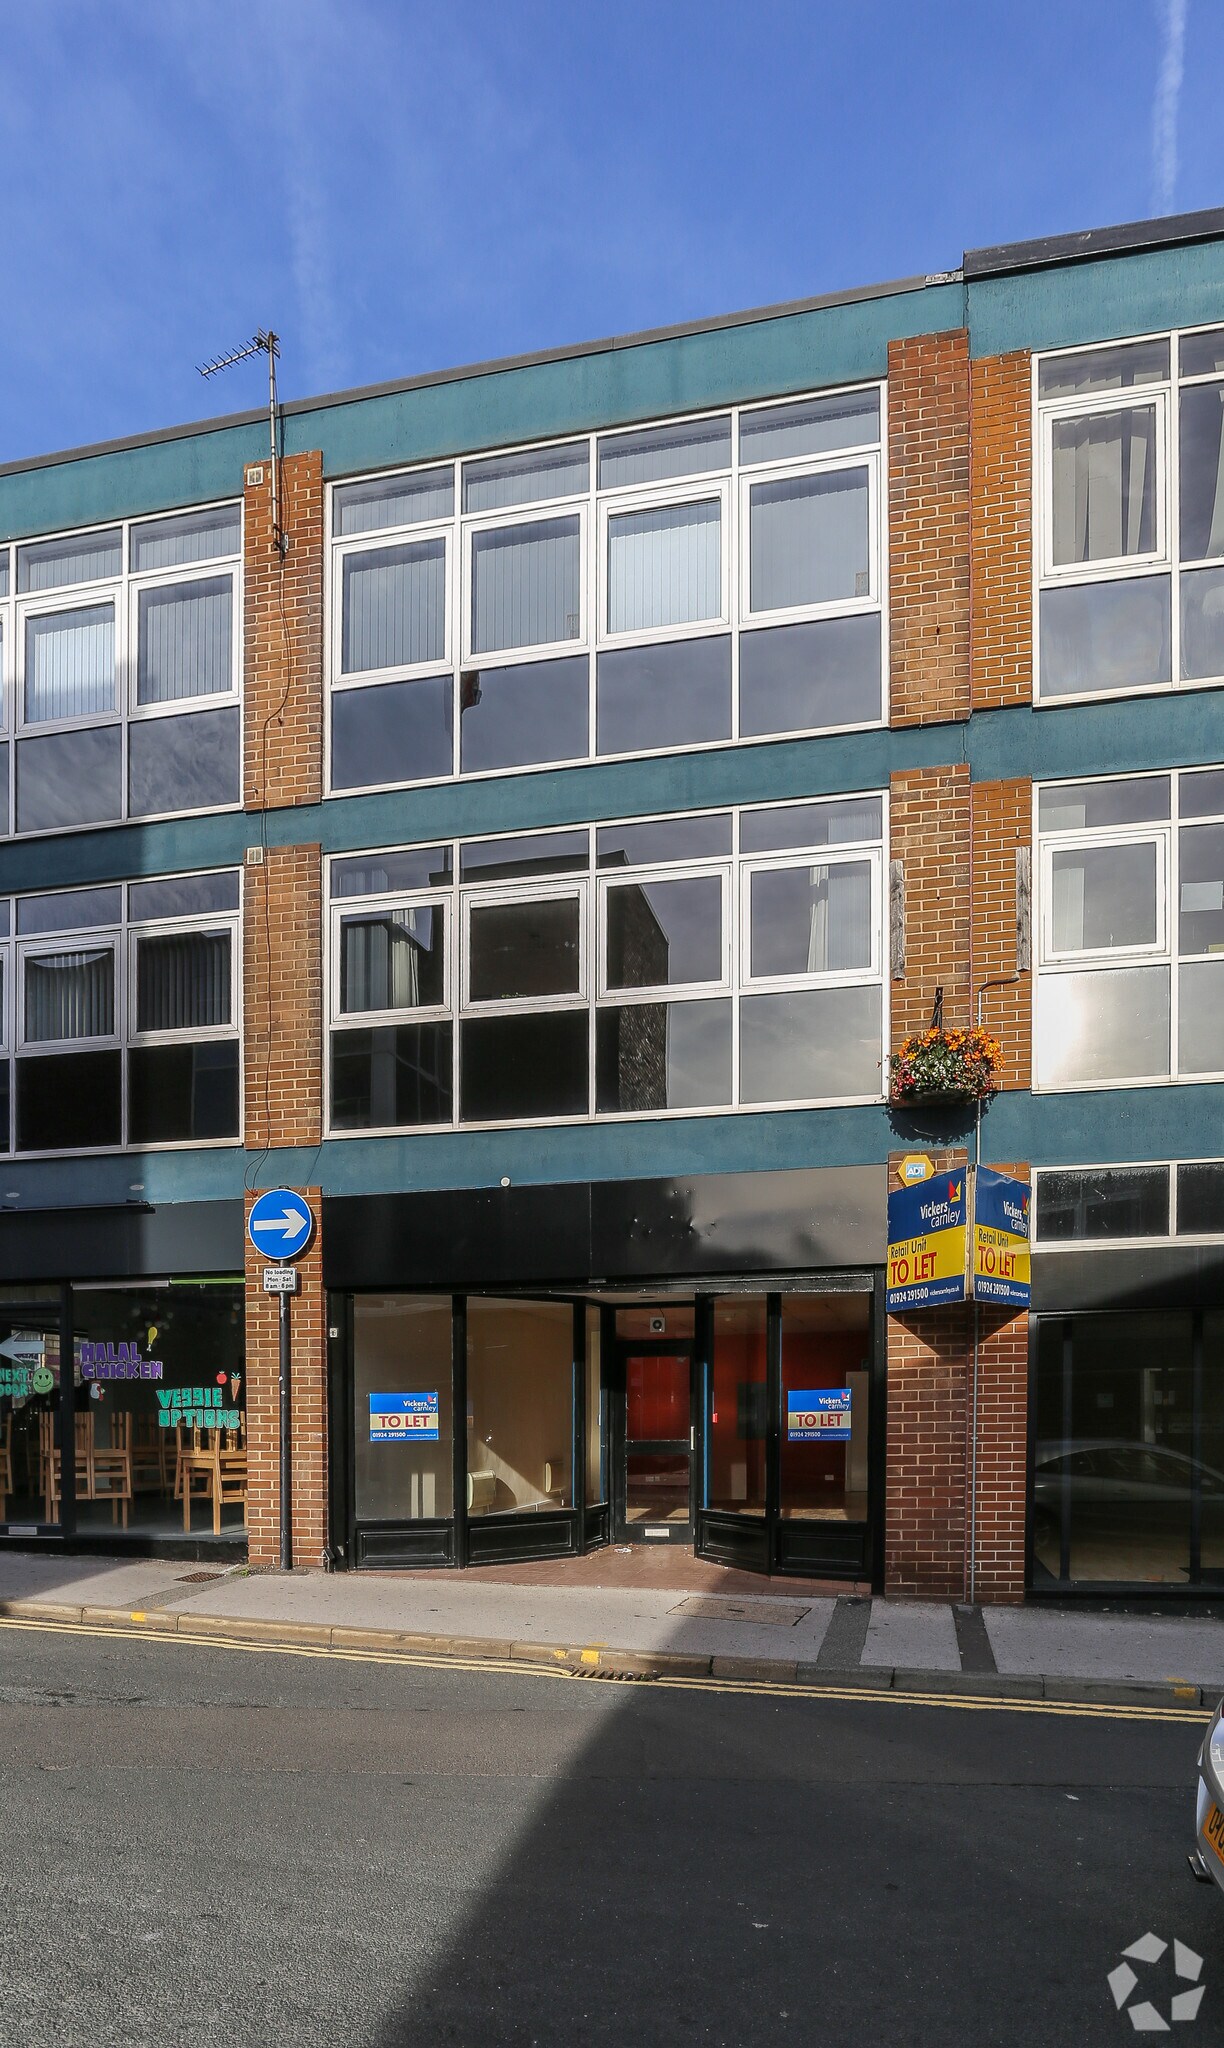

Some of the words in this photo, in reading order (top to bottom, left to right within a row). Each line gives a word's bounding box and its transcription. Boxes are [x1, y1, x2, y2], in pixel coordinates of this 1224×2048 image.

[906, 1166, 926, 1176] ADT
[920, 1201, 948, 1220] Vickers
[931, 1208, 961, 1228] carnley
[1003, 1200, 1022, 1220] Vickers
[1011, 1217, 1028, 1237] carnley
[891, 1241, 909, 1259] Retail
[911, 1237, 927, 1254] Unit
[978, 1228, 996, 1245] Retail
[997, 1233, 1009, 1248] Unit
[890, 1258, 910, 1285] TO
[914, 1251, 937, 1281] LET
[978, 1245, 996, 1274] TO
[999, 1249, 1017, 1278] LET
[889, 1291, 907, 1304] 01924
[907, 1287, 929, 1301] 291500
[977, 1280, 993, 1294] 01924
[993, 1284, 1011, 1297] 291500
[80, 1342, 142, 1363] HALAL
[81, 1361, 163, 1380] CHICKEN
[156, 1388, 223, 1408] VEGGIE
[818, 1397, 841, 1405] Vickers
[158, 1409, 240, 1429] OPTIONS
[378, 1415, 401, 1428] TO
[405, 1415, 430, 1428] LET
[796, 1413, 817, 1427] TO
[820, 1413, 843, 1427] LET
